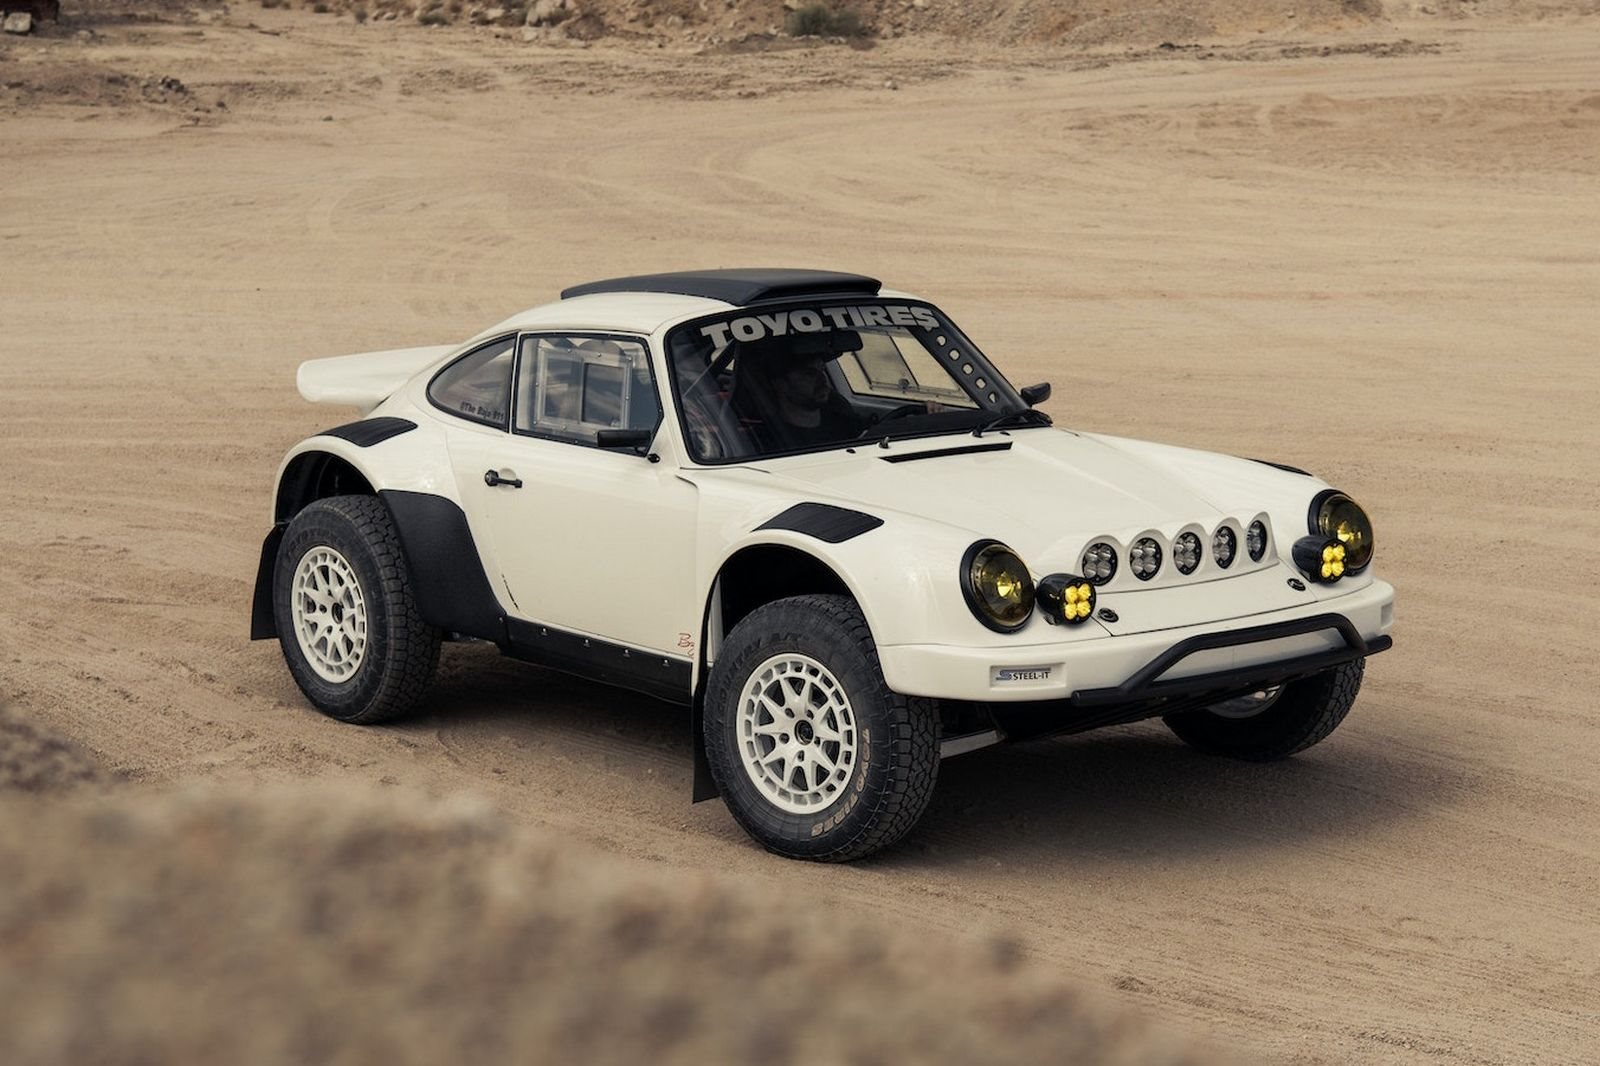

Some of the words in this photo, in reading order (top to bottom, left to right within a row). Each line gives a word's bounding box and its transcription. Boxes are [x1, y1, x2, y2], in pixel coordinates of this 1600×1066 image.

[700, 309, 824, 349] TOYO
[821, 304, 940, 331] TIRES
[1012, 671, 1050, 681] STEEL-IT
[856, 728, 870, 792] TOYO
[811, 792, 858, 837] TIRES
